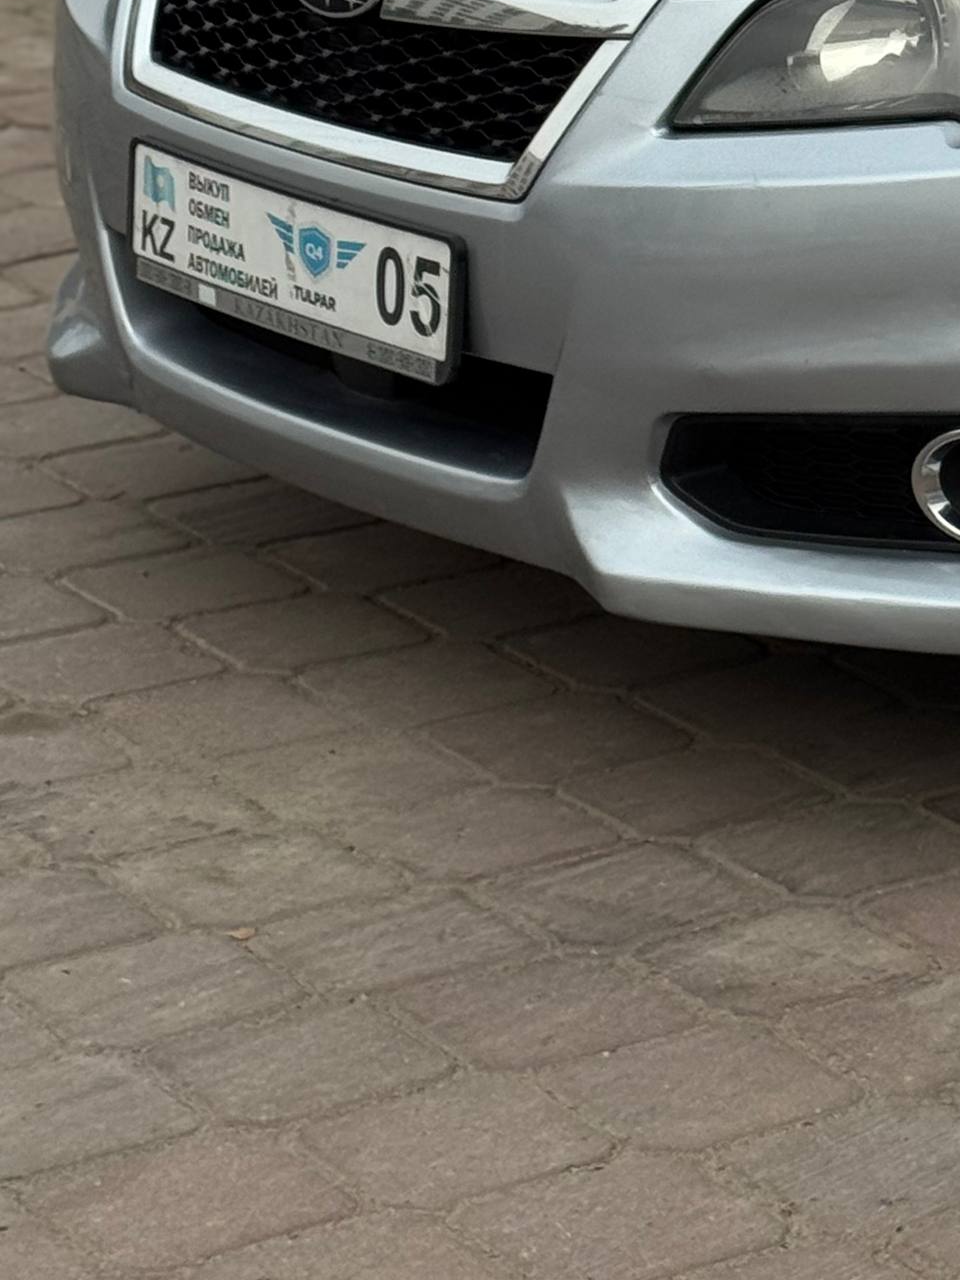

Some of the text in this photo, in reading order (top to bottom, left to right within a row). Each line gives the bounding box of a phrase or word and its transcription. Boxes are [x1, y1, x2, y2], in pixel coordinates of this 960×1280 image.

[188, 172, 230, 202] ВЫКУП
[188, 198, 230, 228] ОБМЕН
[140, 209, 176, 262] KZ
[187, 225, 246, 262] ПРОДАЖА
[187, 253, 278, 301] АВТОМОБИЛЕЙ
[376, 246, 441, 337] 05
[294, 285, 337, 312] TULPAR
